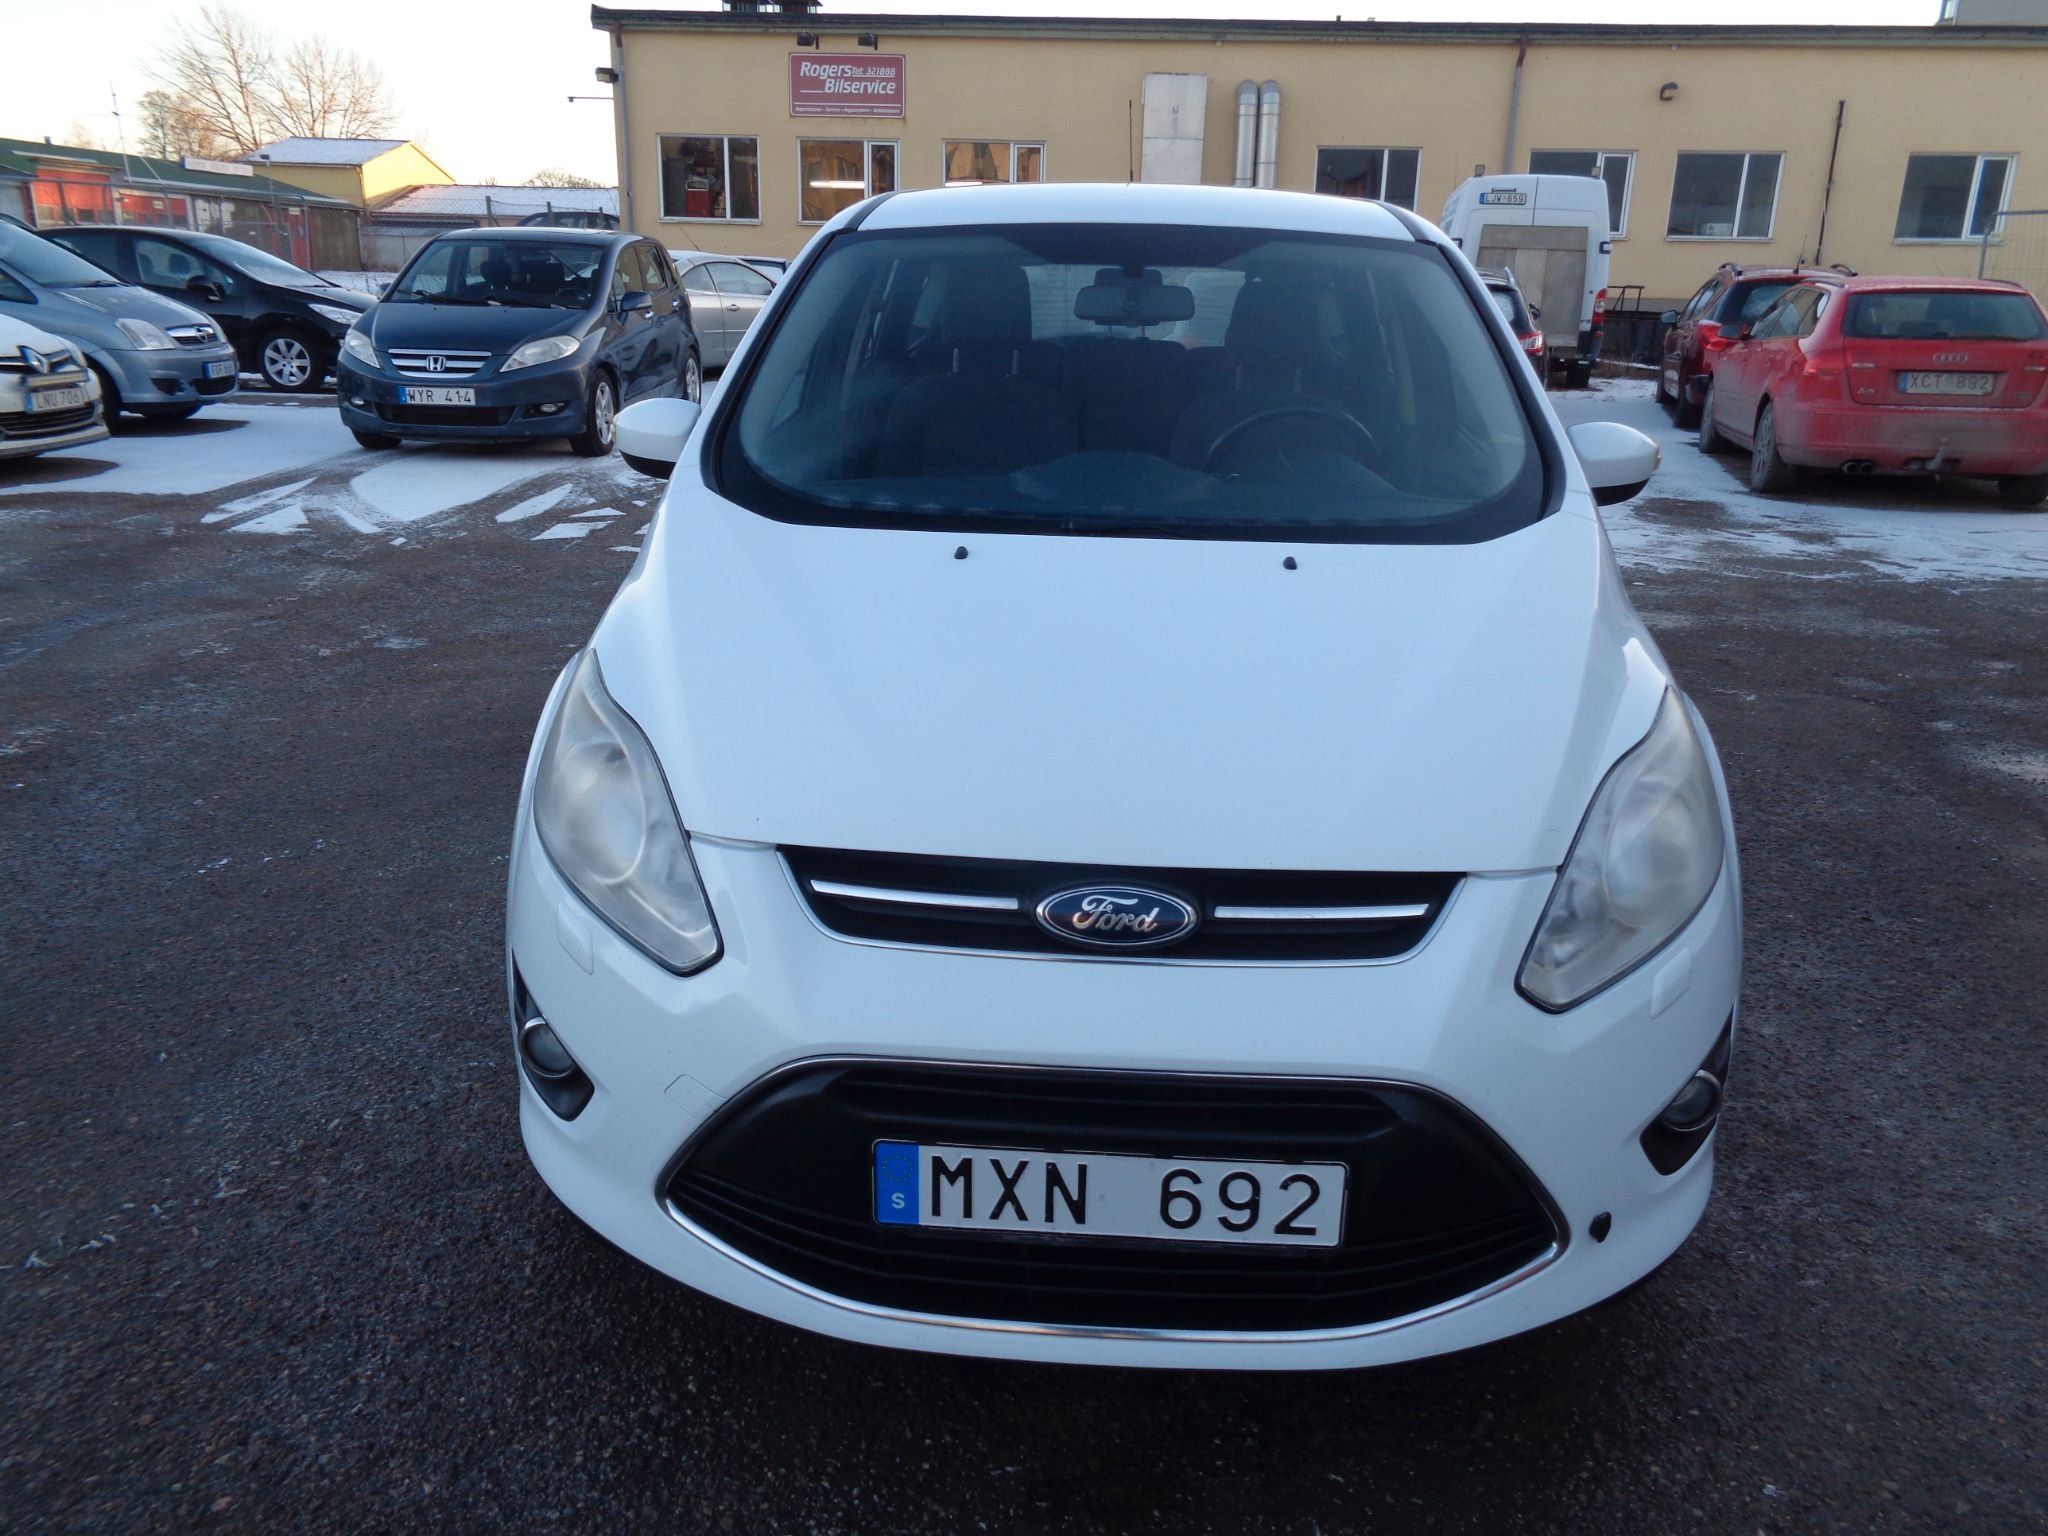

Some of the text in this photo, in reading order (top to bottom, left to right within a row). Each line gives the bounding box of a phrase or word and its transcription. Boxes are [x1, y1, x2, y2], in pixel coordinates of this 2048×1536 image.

[800, 62, 852, 79] Rogers
[867, 67, 896, 76] 321888
[824, 79, 896, 94] Bilservice
[1910, 374, 1989, 390] XCT 892
[407, 389, 471, 403] WYR 414
[1072, 895, 1160, 932] Ford
[891, 1193, 905, 1209] S
[931, 1155, 1321, 1236] MXN 692
